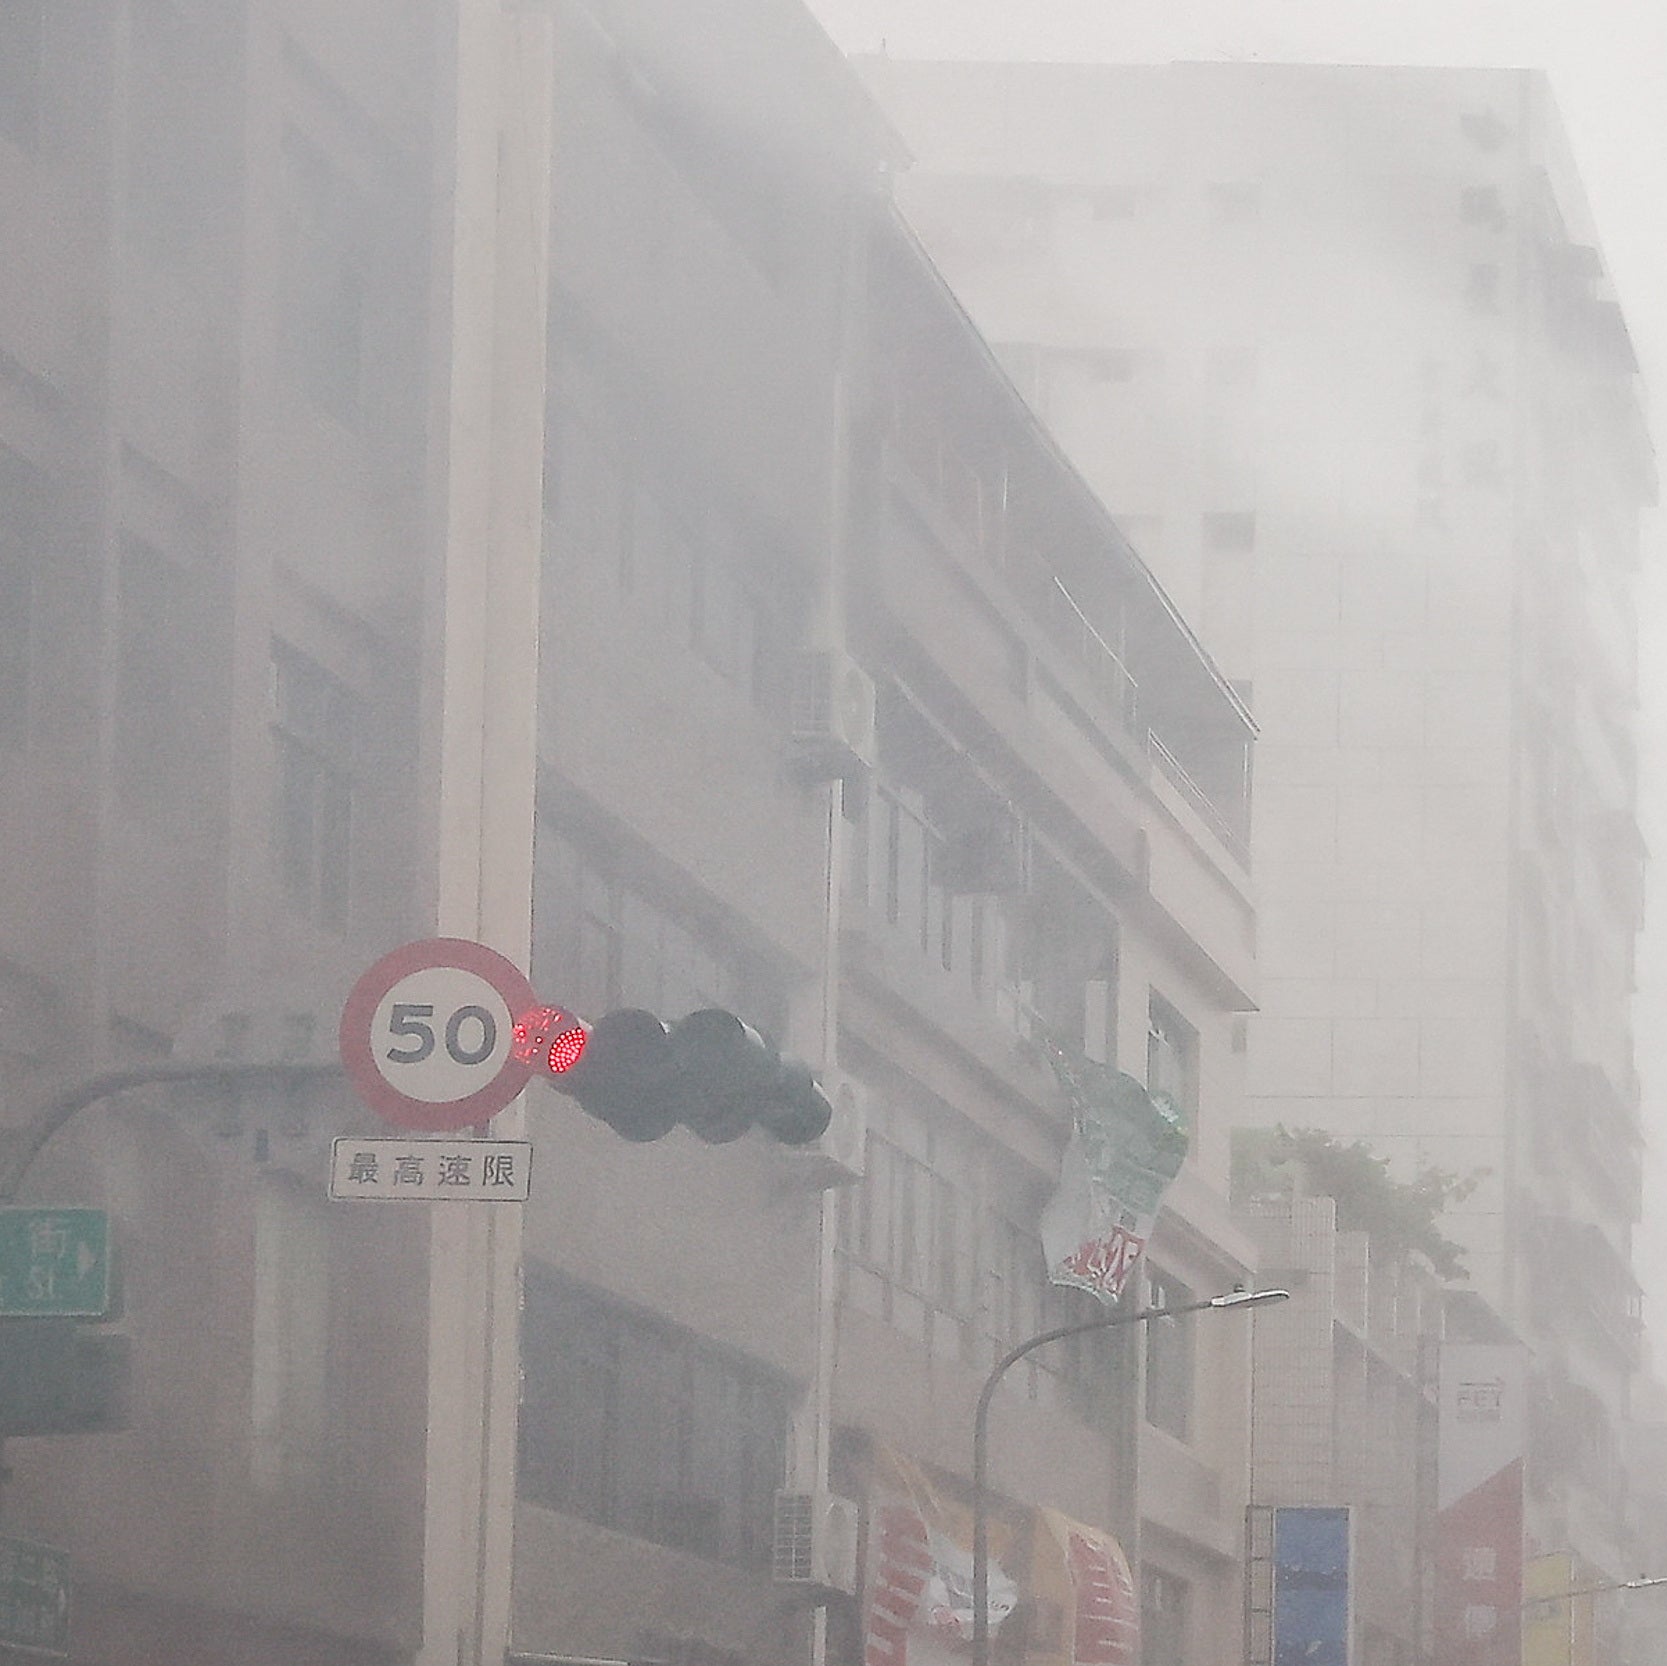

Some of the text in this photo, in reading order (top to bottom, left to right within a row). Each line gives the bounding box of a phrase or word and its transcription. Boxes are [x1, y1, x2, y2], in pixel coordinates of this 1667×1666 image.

[386, 1004, 497, 1065] 50
[348, 1152, 515, 1187] 最高速限
